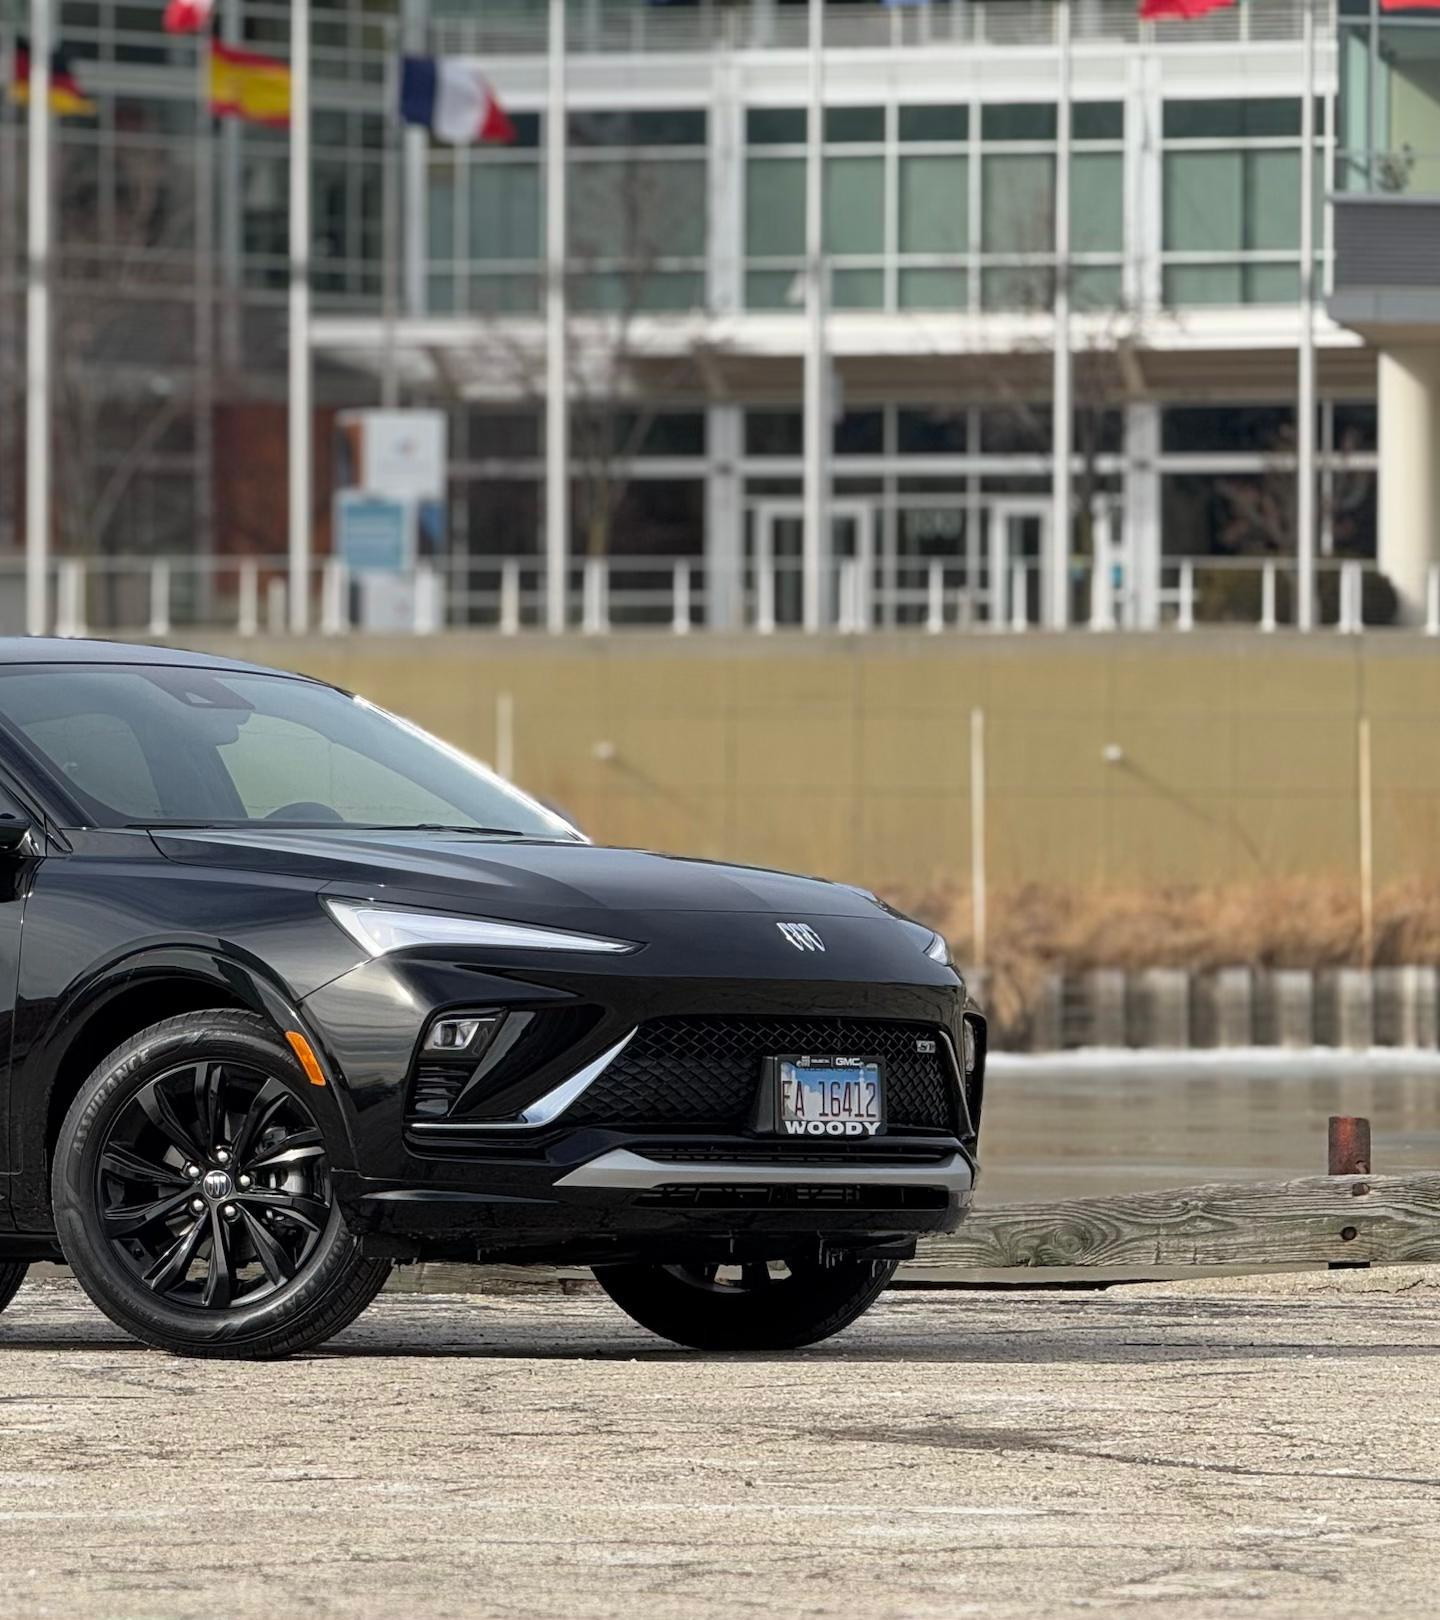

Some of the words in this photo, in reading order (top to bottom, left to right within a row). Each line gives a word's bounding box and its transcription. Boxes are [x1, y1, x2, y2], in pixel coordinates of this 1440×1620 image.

[835, 1057, 861, 1066] GMC
[73, 1048, 150, 1155] ASSURANCE
[818, 1081, 877, 1118] 16412
[784, 1120, 882, 1136] WOODY
